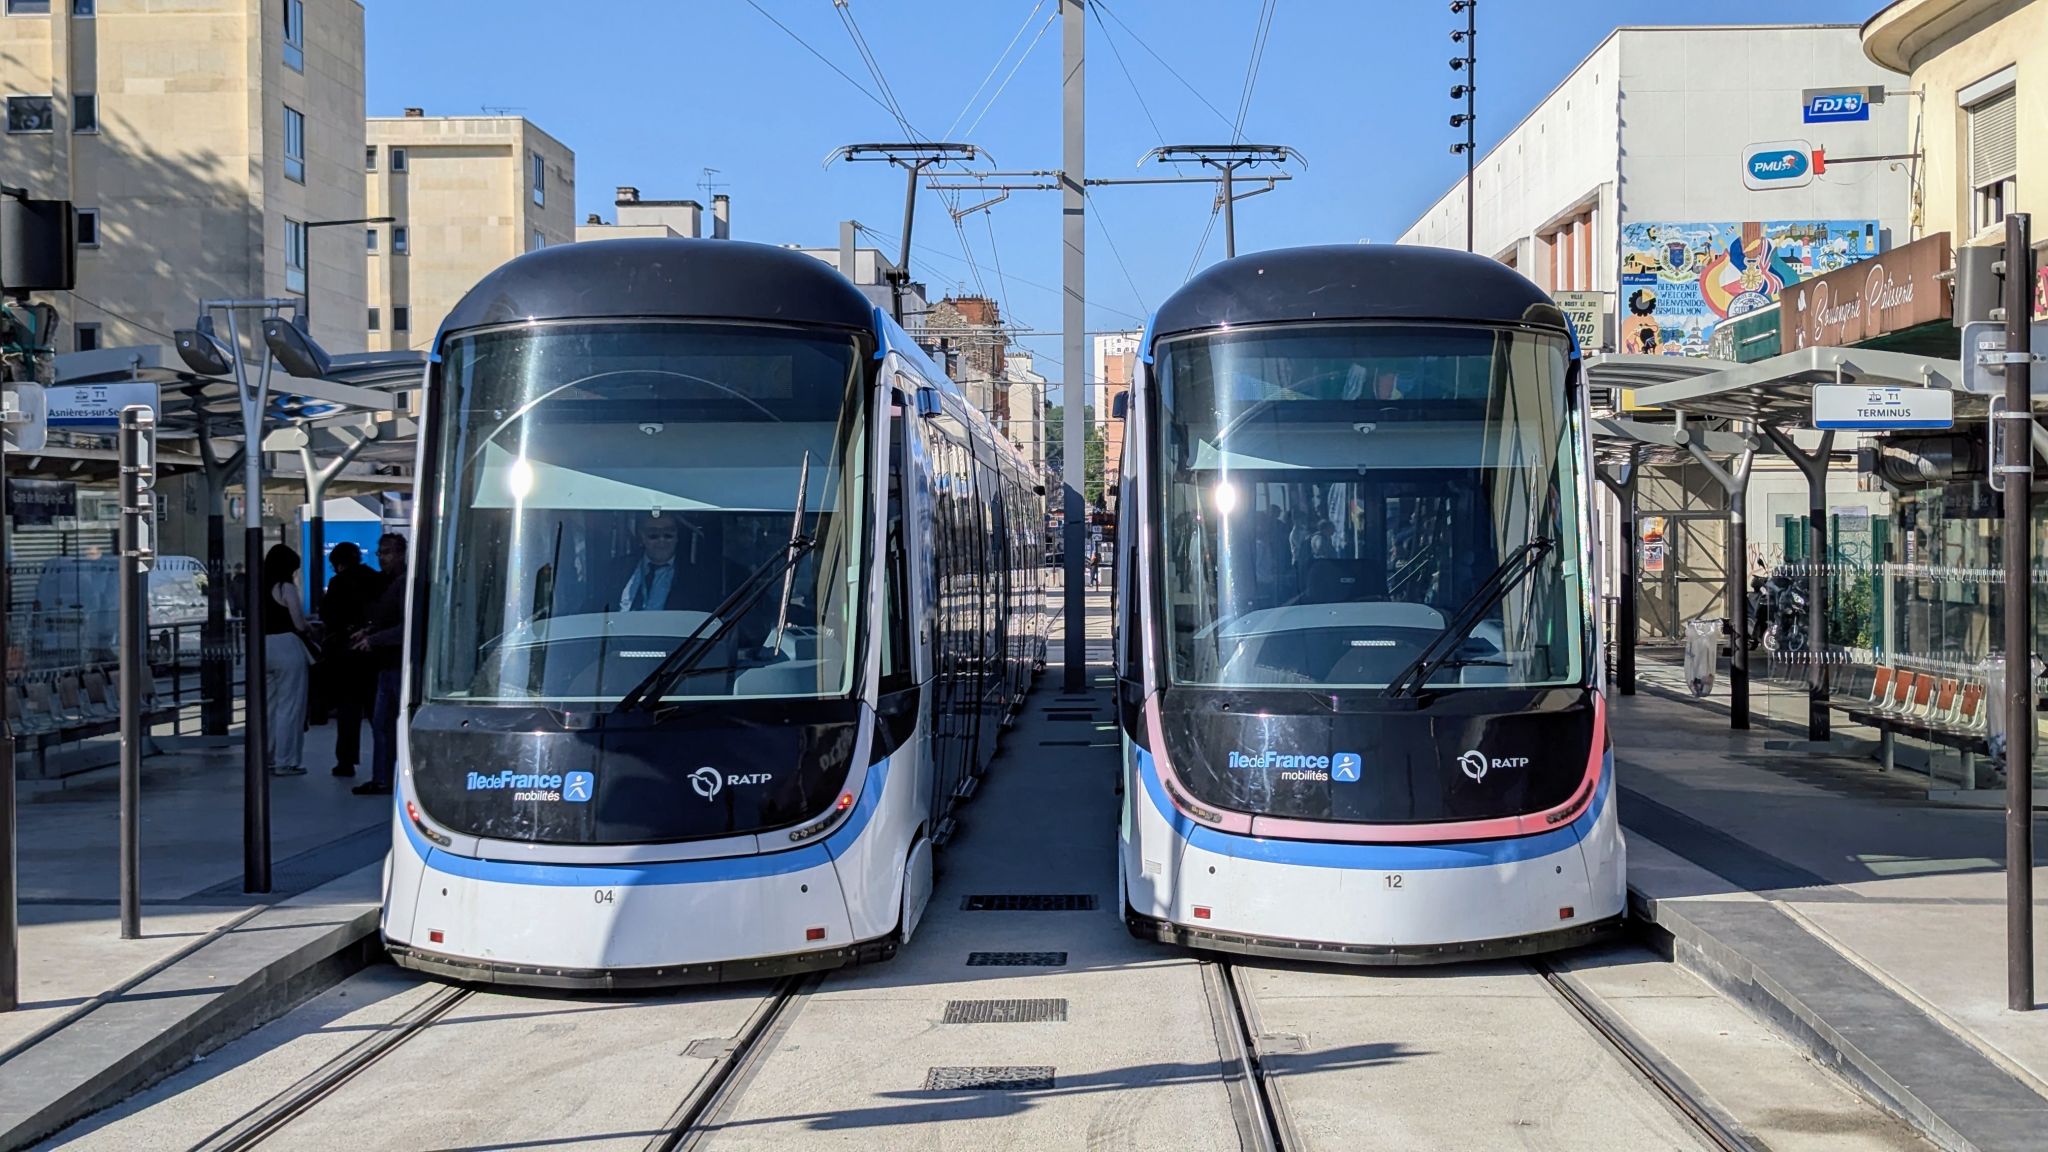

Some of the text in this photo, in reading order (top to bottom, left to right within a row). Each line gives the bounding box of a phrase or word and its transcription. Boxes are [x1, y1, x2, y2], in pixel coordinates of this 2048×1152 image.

[1813, 98, 1843, 112] FDJ
[1754, 161, 1783, 173] PMU
[1661, 291, 1698, 299] WELCOME
[1657, 299, 1706, 307] BIENVENIDOS
[1811, 264, 1914, 341] Boulangerie Pâtisserie
[95, 390, 105, 398] T1
[48, 408, 120, 417] Asnières-sur-Se
[1857, 408, 1911, 417] TERMINUS
[1491, 757, 1529, 769] RATP
[727, 773, 773, 785] RATP
[1281, 769, 1328, 781] mobilités
[514, 790, 560, 801] mobilités
[1384, 874, 1403, 888] 12
[594, 889, 614, 904] 04
